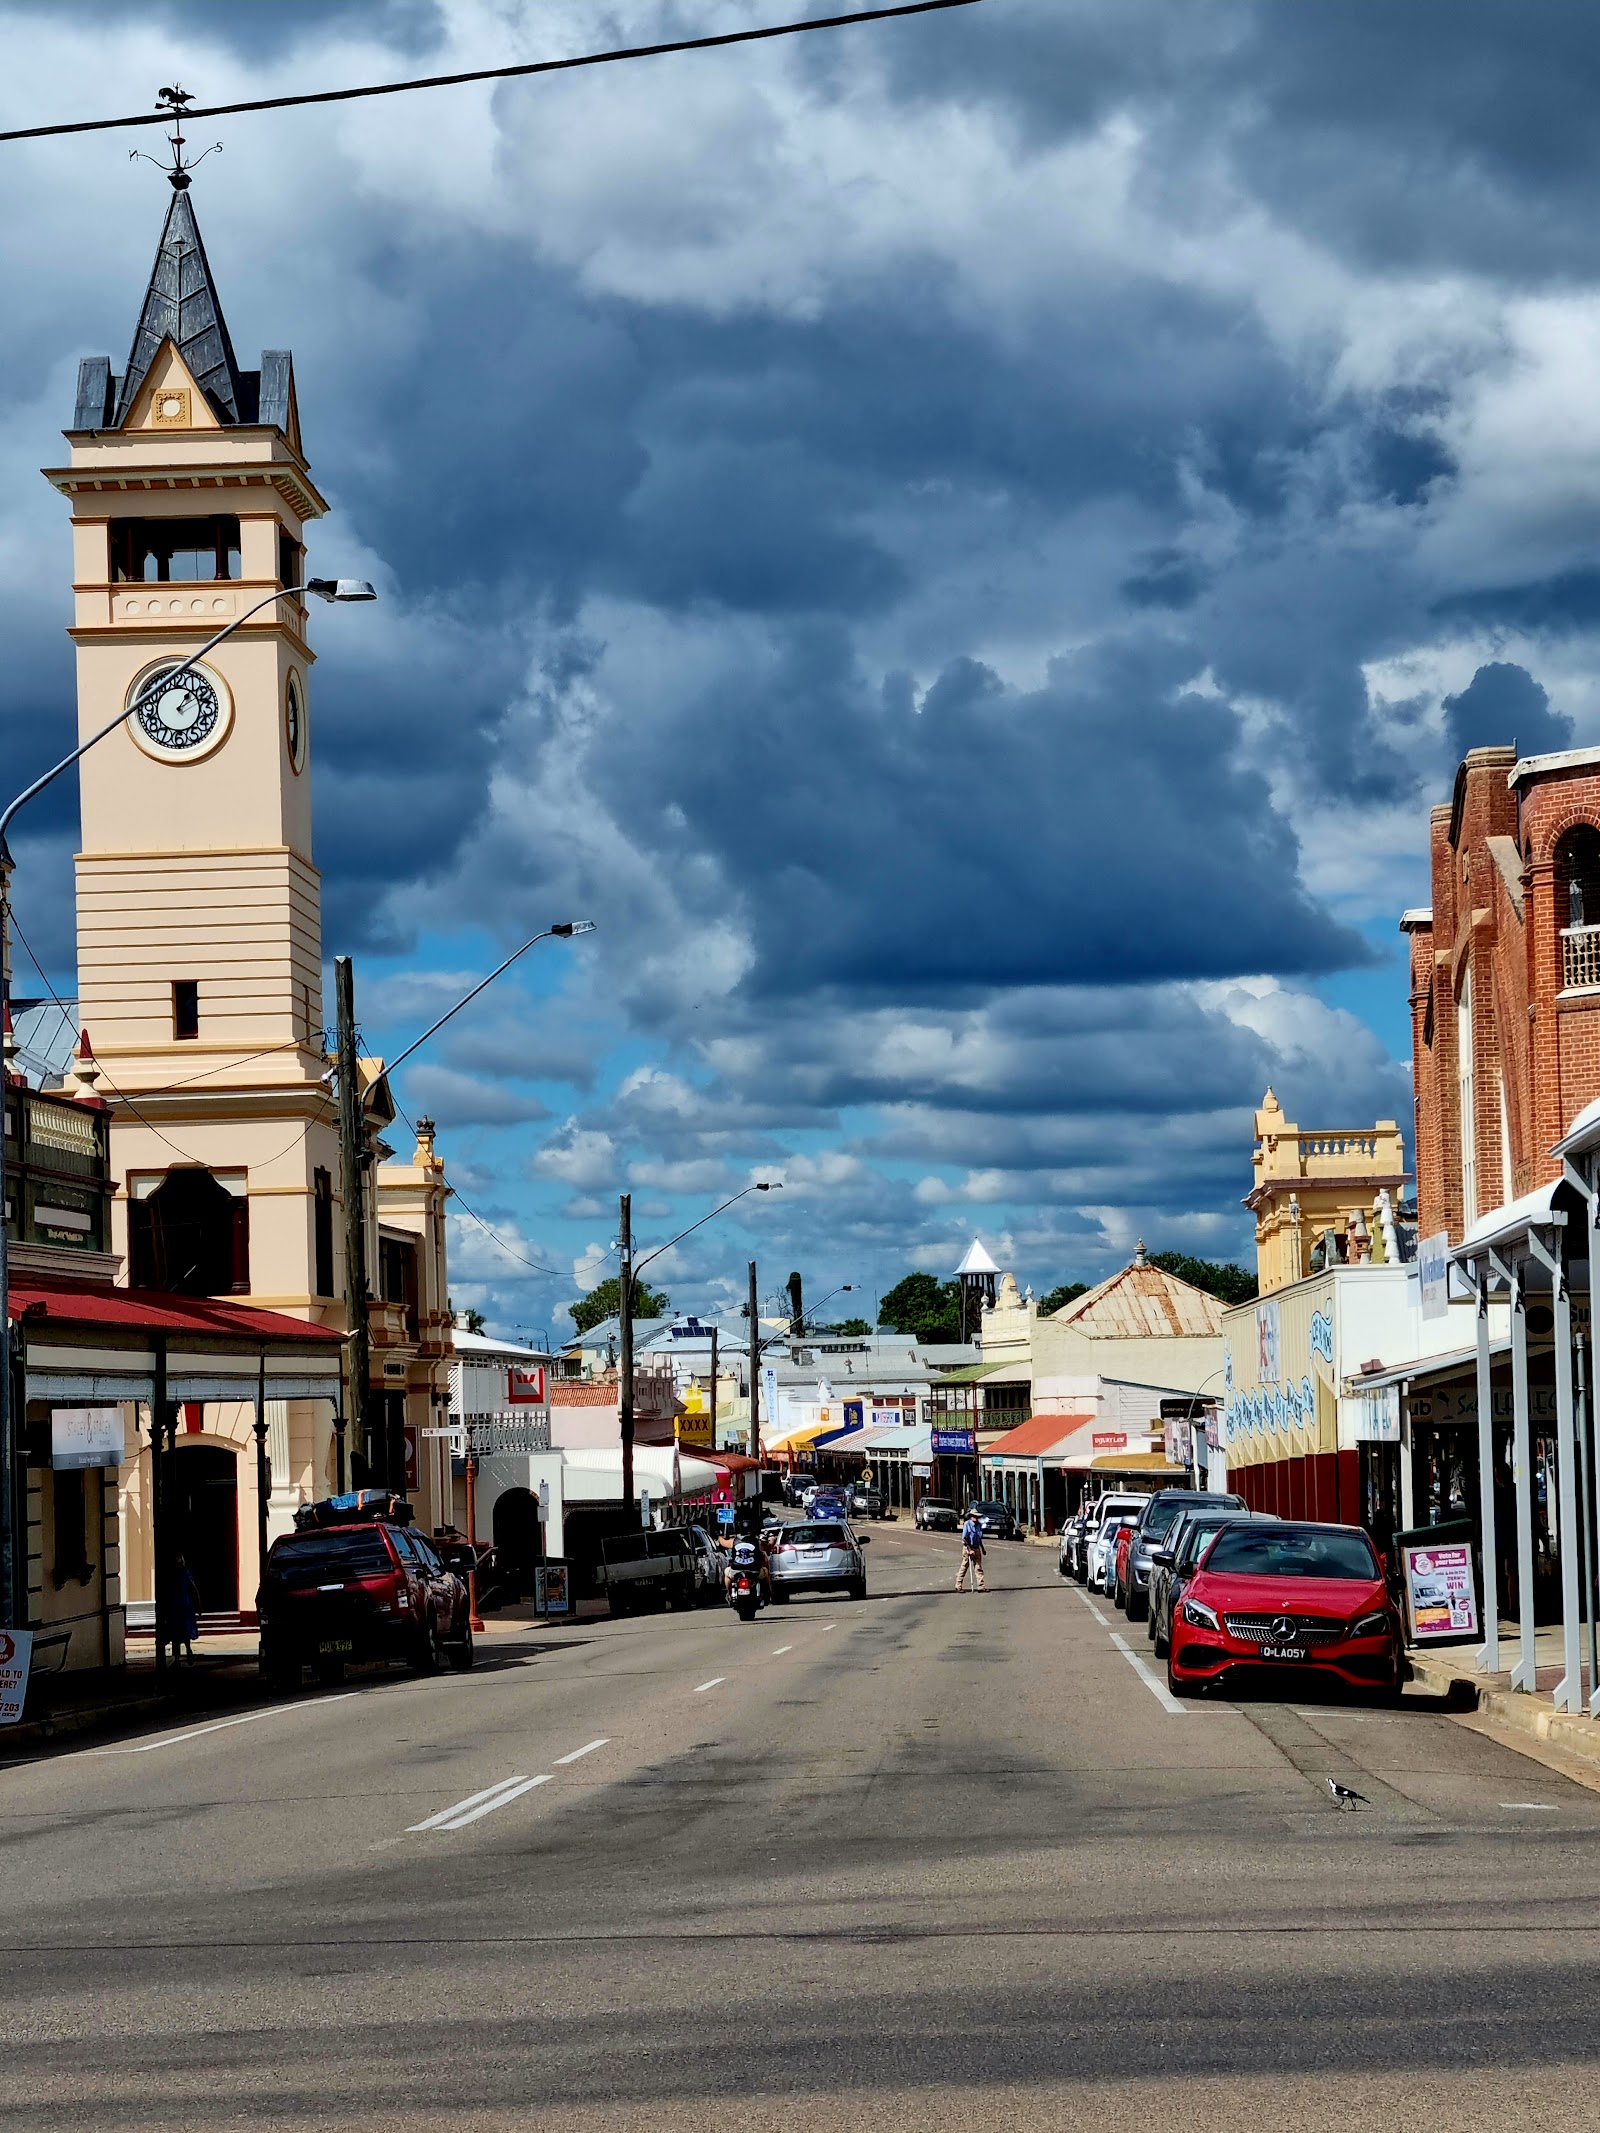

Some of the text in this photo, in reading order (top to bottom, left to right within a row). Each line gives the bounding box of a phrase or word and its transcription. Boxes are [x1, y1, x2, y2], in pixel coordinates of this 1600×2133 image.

[680, 1419, 709, 1431] XXXX
[0, 1669, 23, 1679] LD TO
